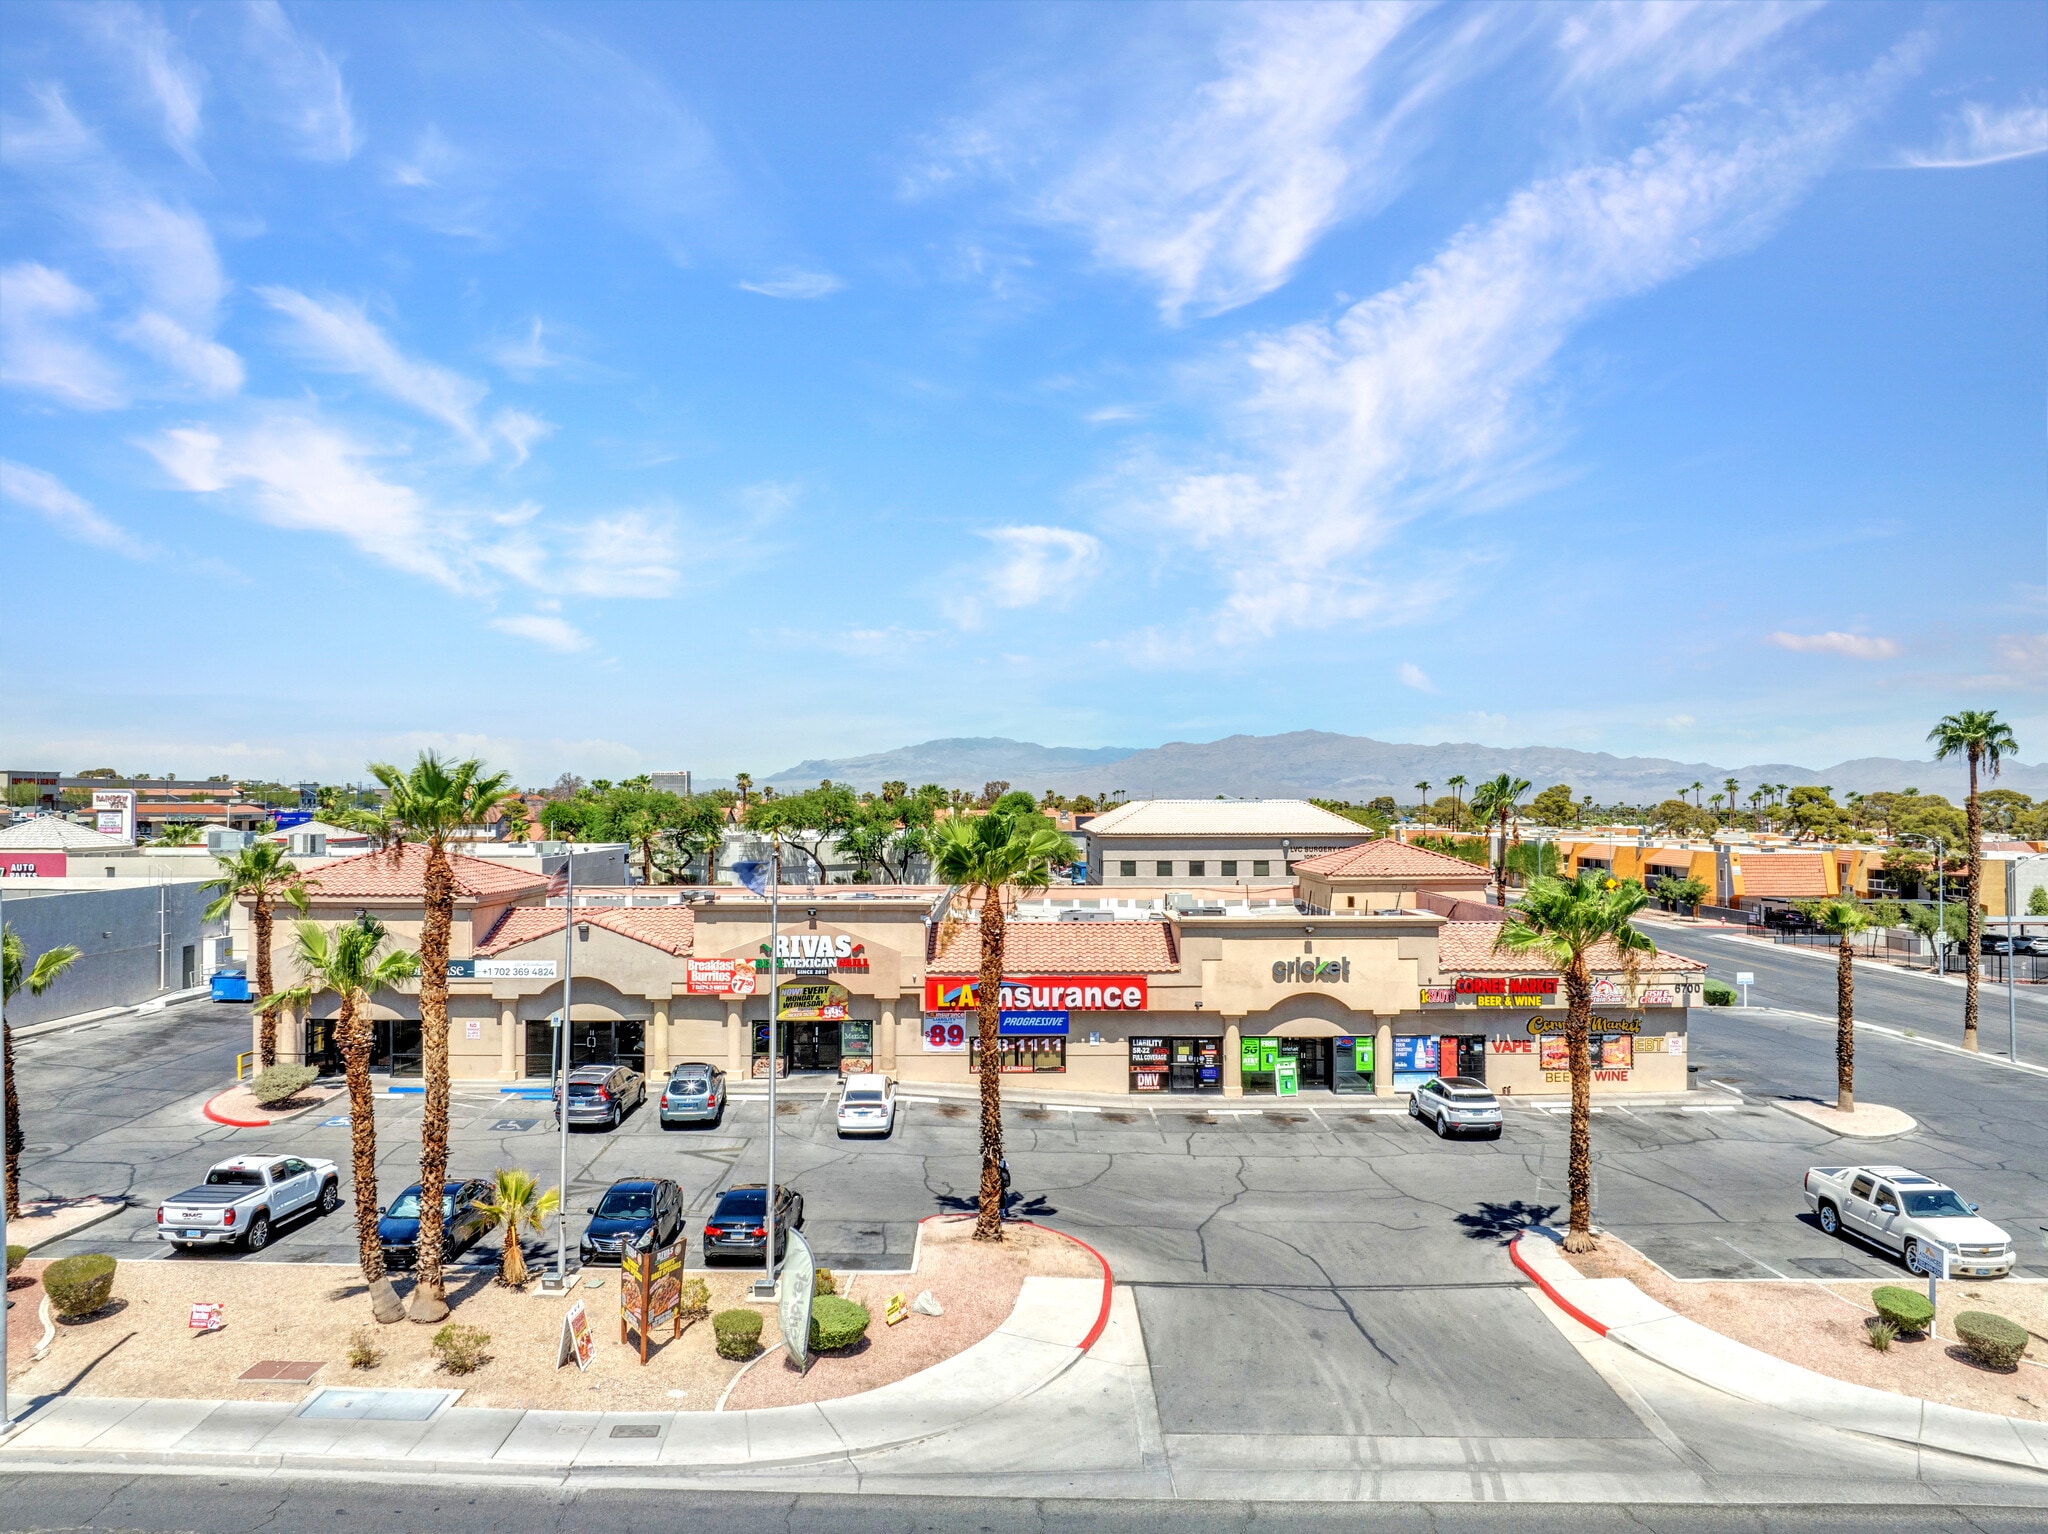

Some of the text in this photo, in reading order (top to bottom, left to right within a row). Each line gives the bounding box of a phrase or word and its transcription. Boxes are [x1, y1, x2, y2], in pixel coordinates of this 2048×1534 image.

[10, 863, 35, 872] AUTO
[772, 935, 852, 958] RIVAS
[687, 959, 735, 971] Breakfast
[755, 958, 869, 968] REL MEXICAN GRILL
[1272, 957, 1350, 977] cricket
[482, 968, 555, 976] +1 702 369 4824
[691, 970, 731, 982] Burritos
[802, 986, 830, 995] EVERY
[1456, 978, 1559, 994] CORNER MARKET
[1675, 983, 1700, 993] 6700
[786, 994, 814, 1002] MONDAY
[998, 986, 1142, 1008] nsurance
[1428, 989, 1456, 1003] SLOTS
[1477, 995, 1541, 1006] BEER & WINE
[783, 1000, 824, 1009] WEDNESDAY
[1003, 1017, 1064, 1026] PROGRESSIVE
[1527, 1015, 1642, 1035] Corn Market
[844, 1032, 869, 1040] Mexican
[1132, 1039, 1163, 1047] LIABILITY
[1492, 1040, 1532, 1053] VAPE
[1635, 1038, 1664, 1052] EBT
[1243, 1046, 1258, 1055] 5G
[1138, 1073, 1160, 1086] DMV
[1545, 1071, 1628, 1083] BEE WINE
